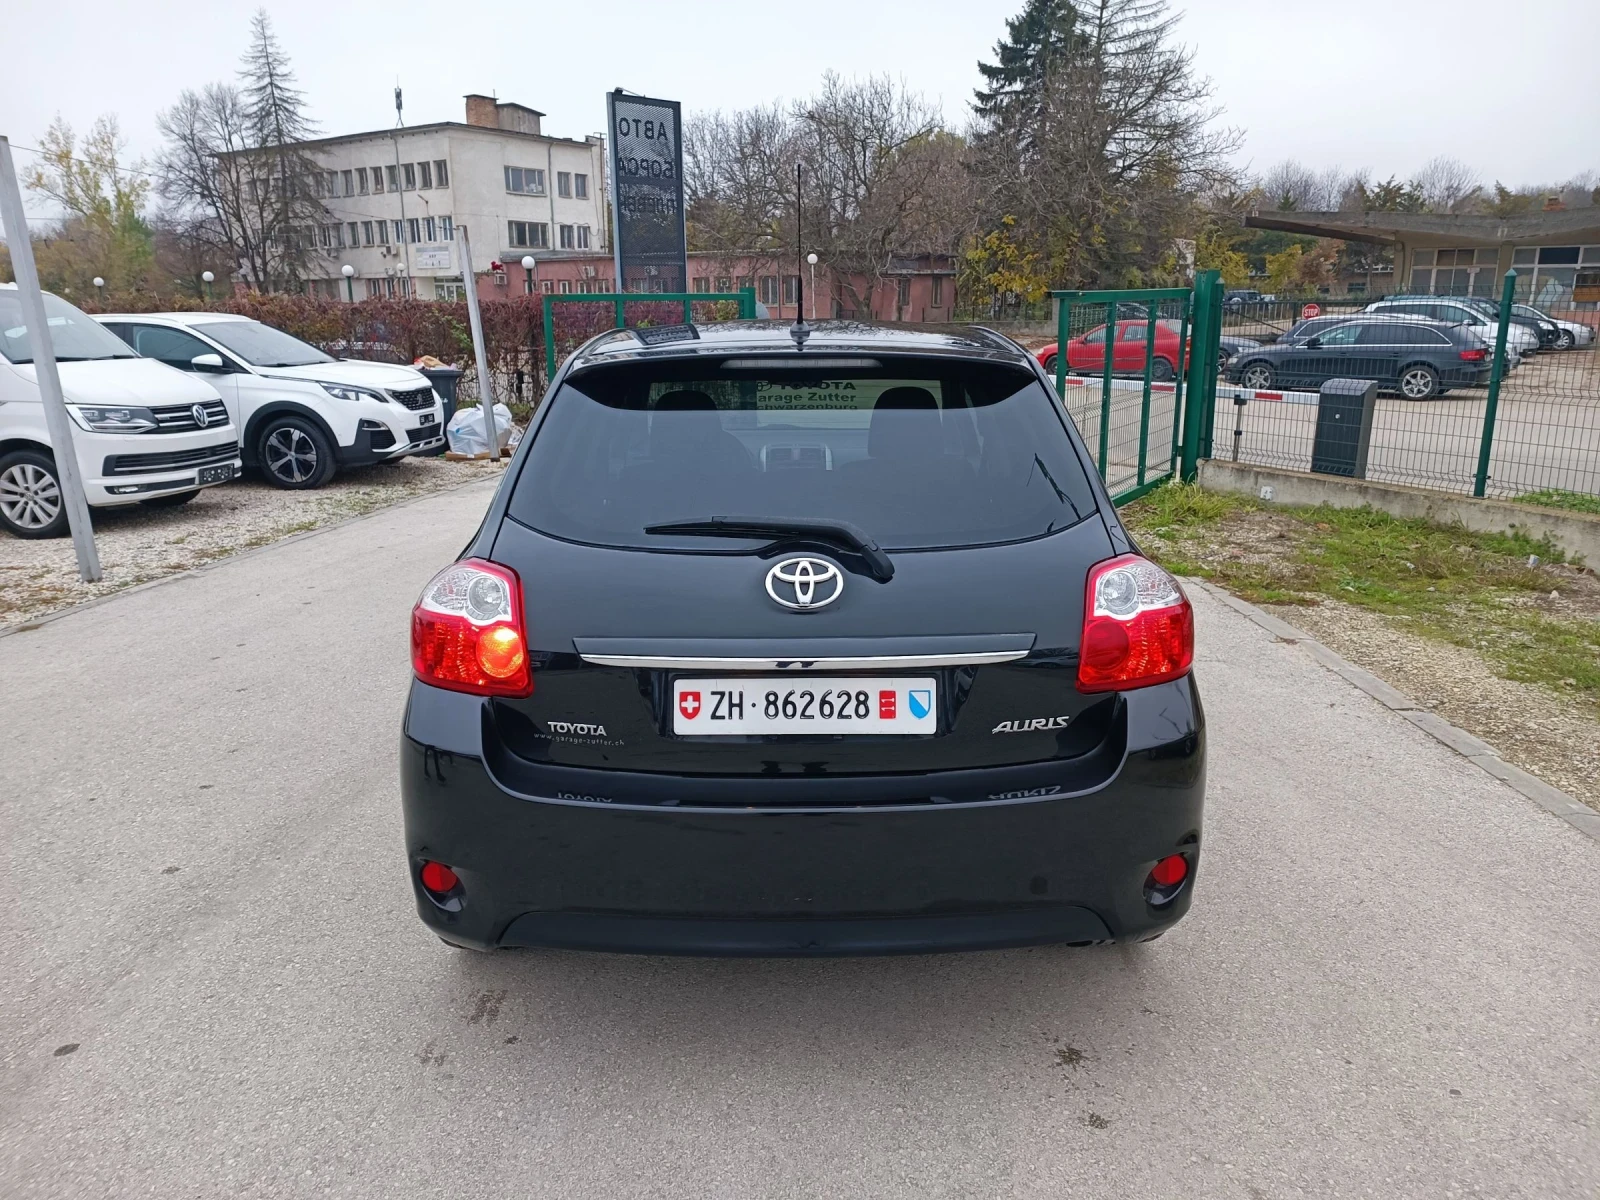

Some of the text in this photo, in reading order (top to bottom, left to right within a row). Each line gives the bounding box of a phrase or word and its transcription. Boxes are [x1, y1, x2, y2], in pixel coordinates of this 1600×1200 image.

[1304, 308, 1318, 317] STOP
[776, 381, 856, 390] TOYOTA
[807, 392, 856, 402] Zutter
[764, 689, 870, 720] 862628
[547, 721, 608, 737] TOYOTA
[991, 715, 1070, 735] AURIS
[533, 733, 625, 746] www.garage-zutter.ch
